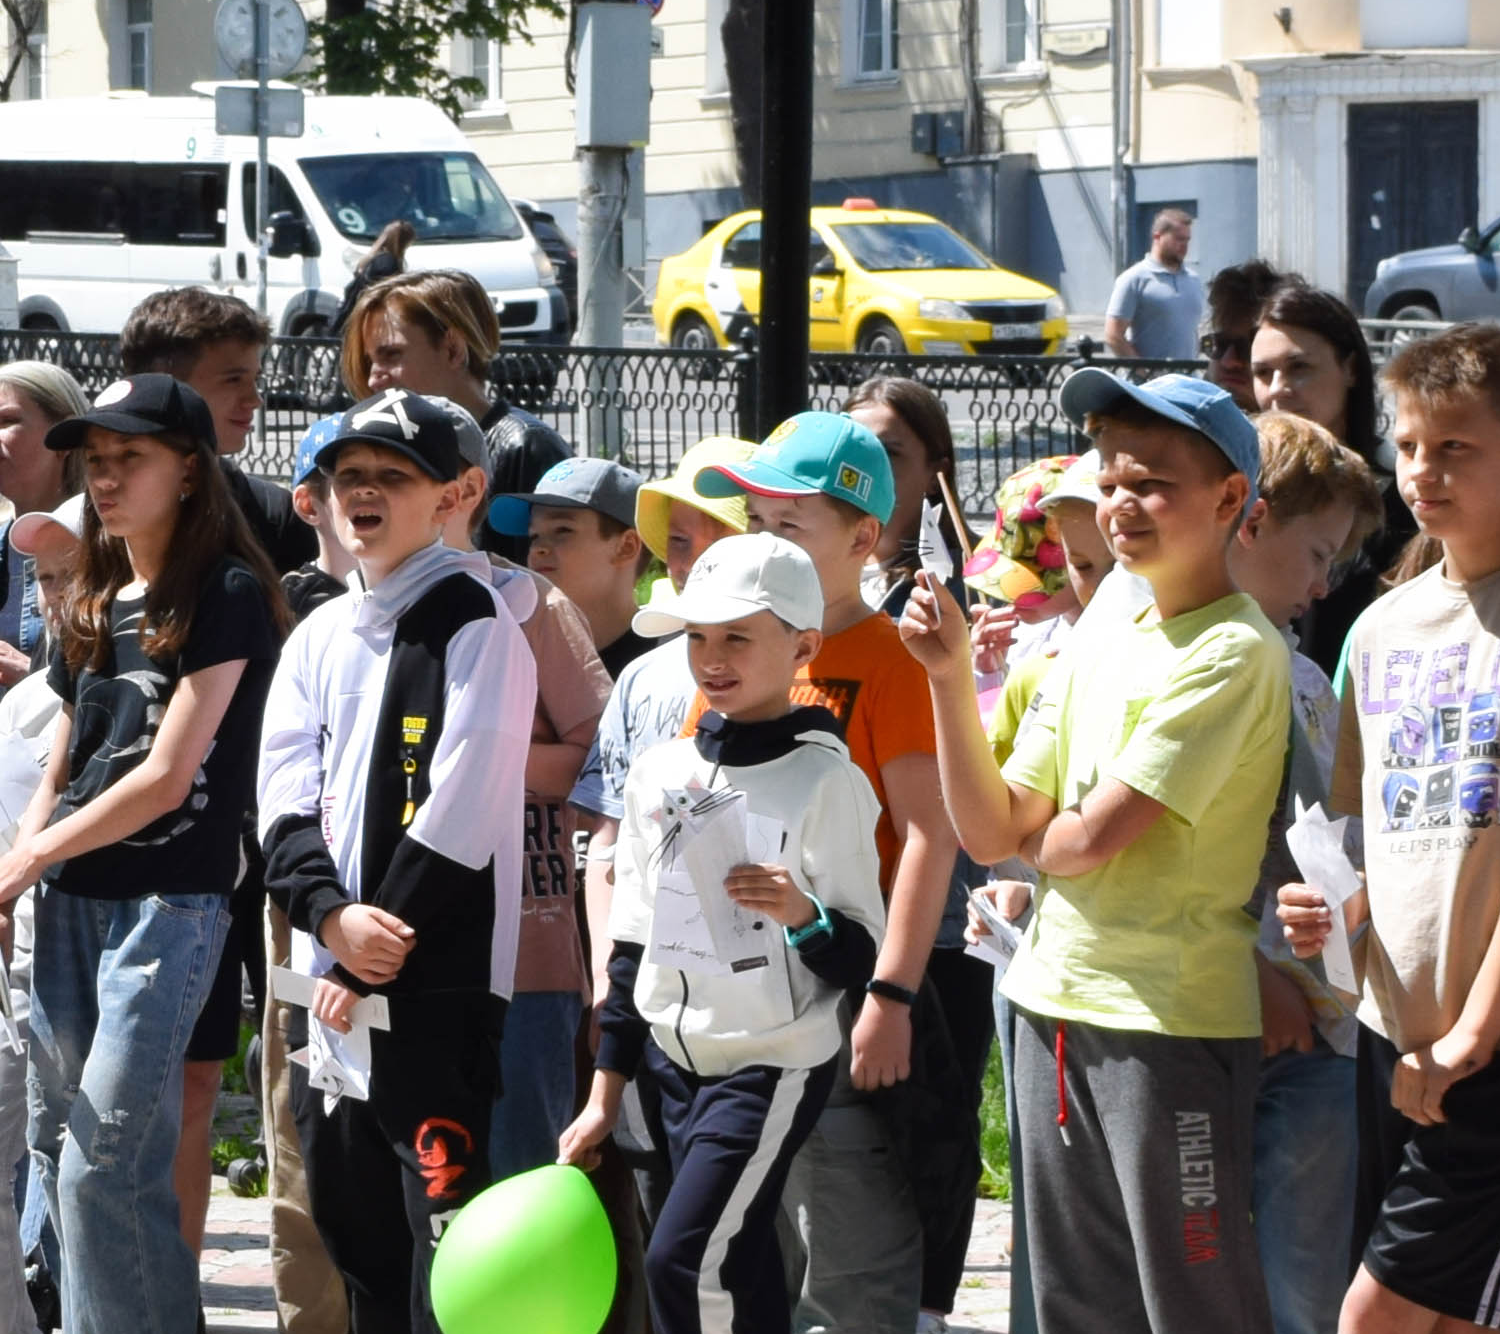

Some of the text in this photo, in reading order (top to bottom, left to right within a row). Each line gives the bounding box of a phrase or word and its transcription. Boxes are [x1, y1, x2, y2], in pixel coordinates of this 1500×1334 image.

[186, 136, 197, 159] 9
[337, 208, 366, 234] 9
[1390, 839, 1432, 854] LET'S
[1175, 1111, 1218, 1206] ATHLETIC
